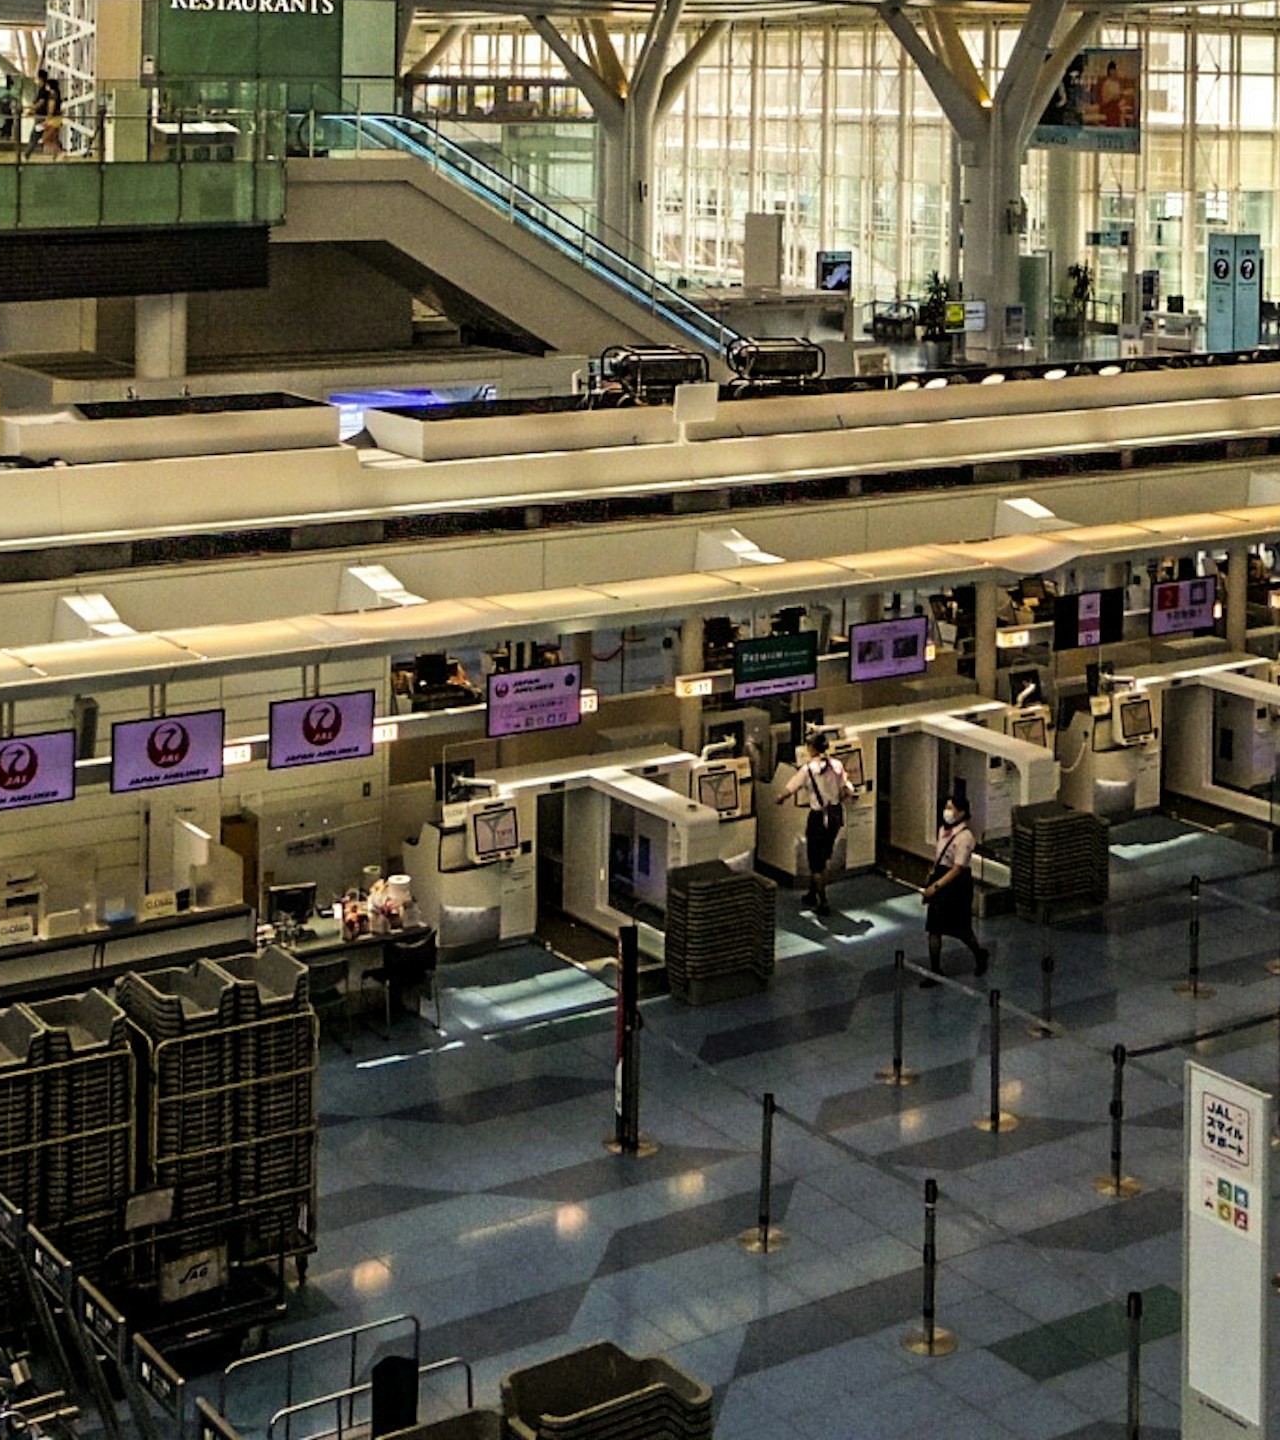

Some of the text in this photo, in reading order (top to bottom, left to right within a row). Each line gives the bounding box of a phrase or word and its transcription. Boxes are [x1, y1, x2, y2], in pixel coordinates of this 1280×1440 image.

[5, 775, 28, 786] JAL
[1207, 1101, 1233, 1121] JAL
[1206, 1115, 1245, 1142] スマイル
[1206, 1131, 1246, 1158] サポート
